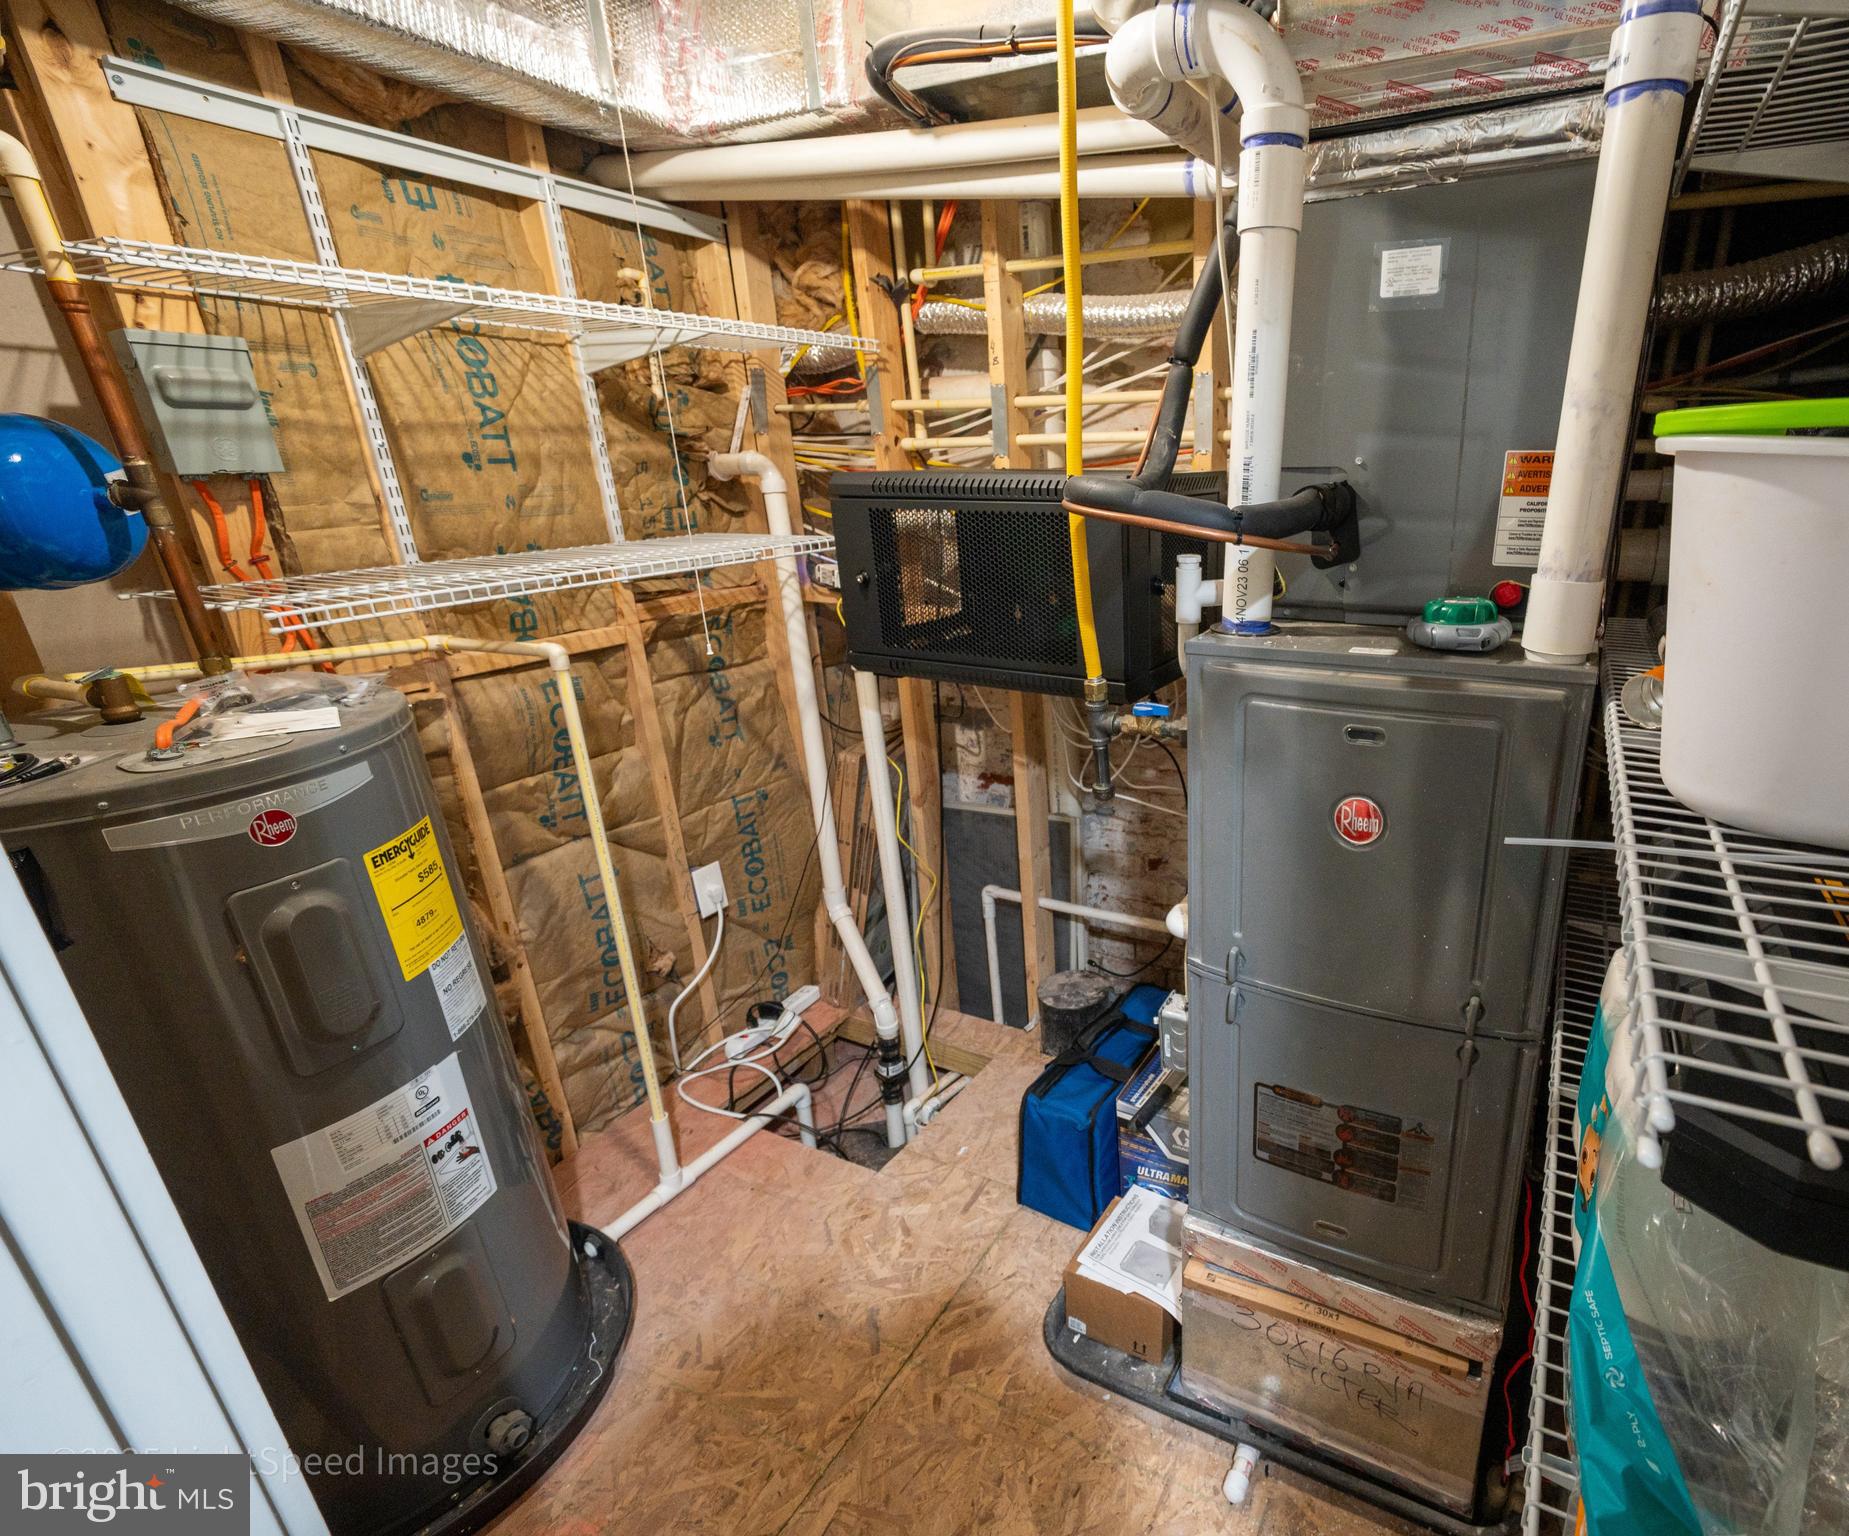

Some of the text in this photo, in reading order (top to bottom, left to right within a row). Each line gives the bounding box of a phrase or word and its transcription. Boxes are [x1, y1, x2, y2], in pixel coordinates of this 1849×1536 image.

[1238, 558, 1250, 574] 06
[180, 778, 329, 831] PERFORMANCE
[1340, 802, 1380, 834] Rheem
[252, 814, 295, 844] Rheem
[371, 822, 431, 870] ENERGYGUIDE
[731, 793, 772, 913] ECOBATT
[432, 959, 441, 971] DO
[443, 983, 452, 995] NO
[435, 1108, 468, 1139] DANGER
[1584, 1289, 1613, 1361] SEPTIC SAFE
